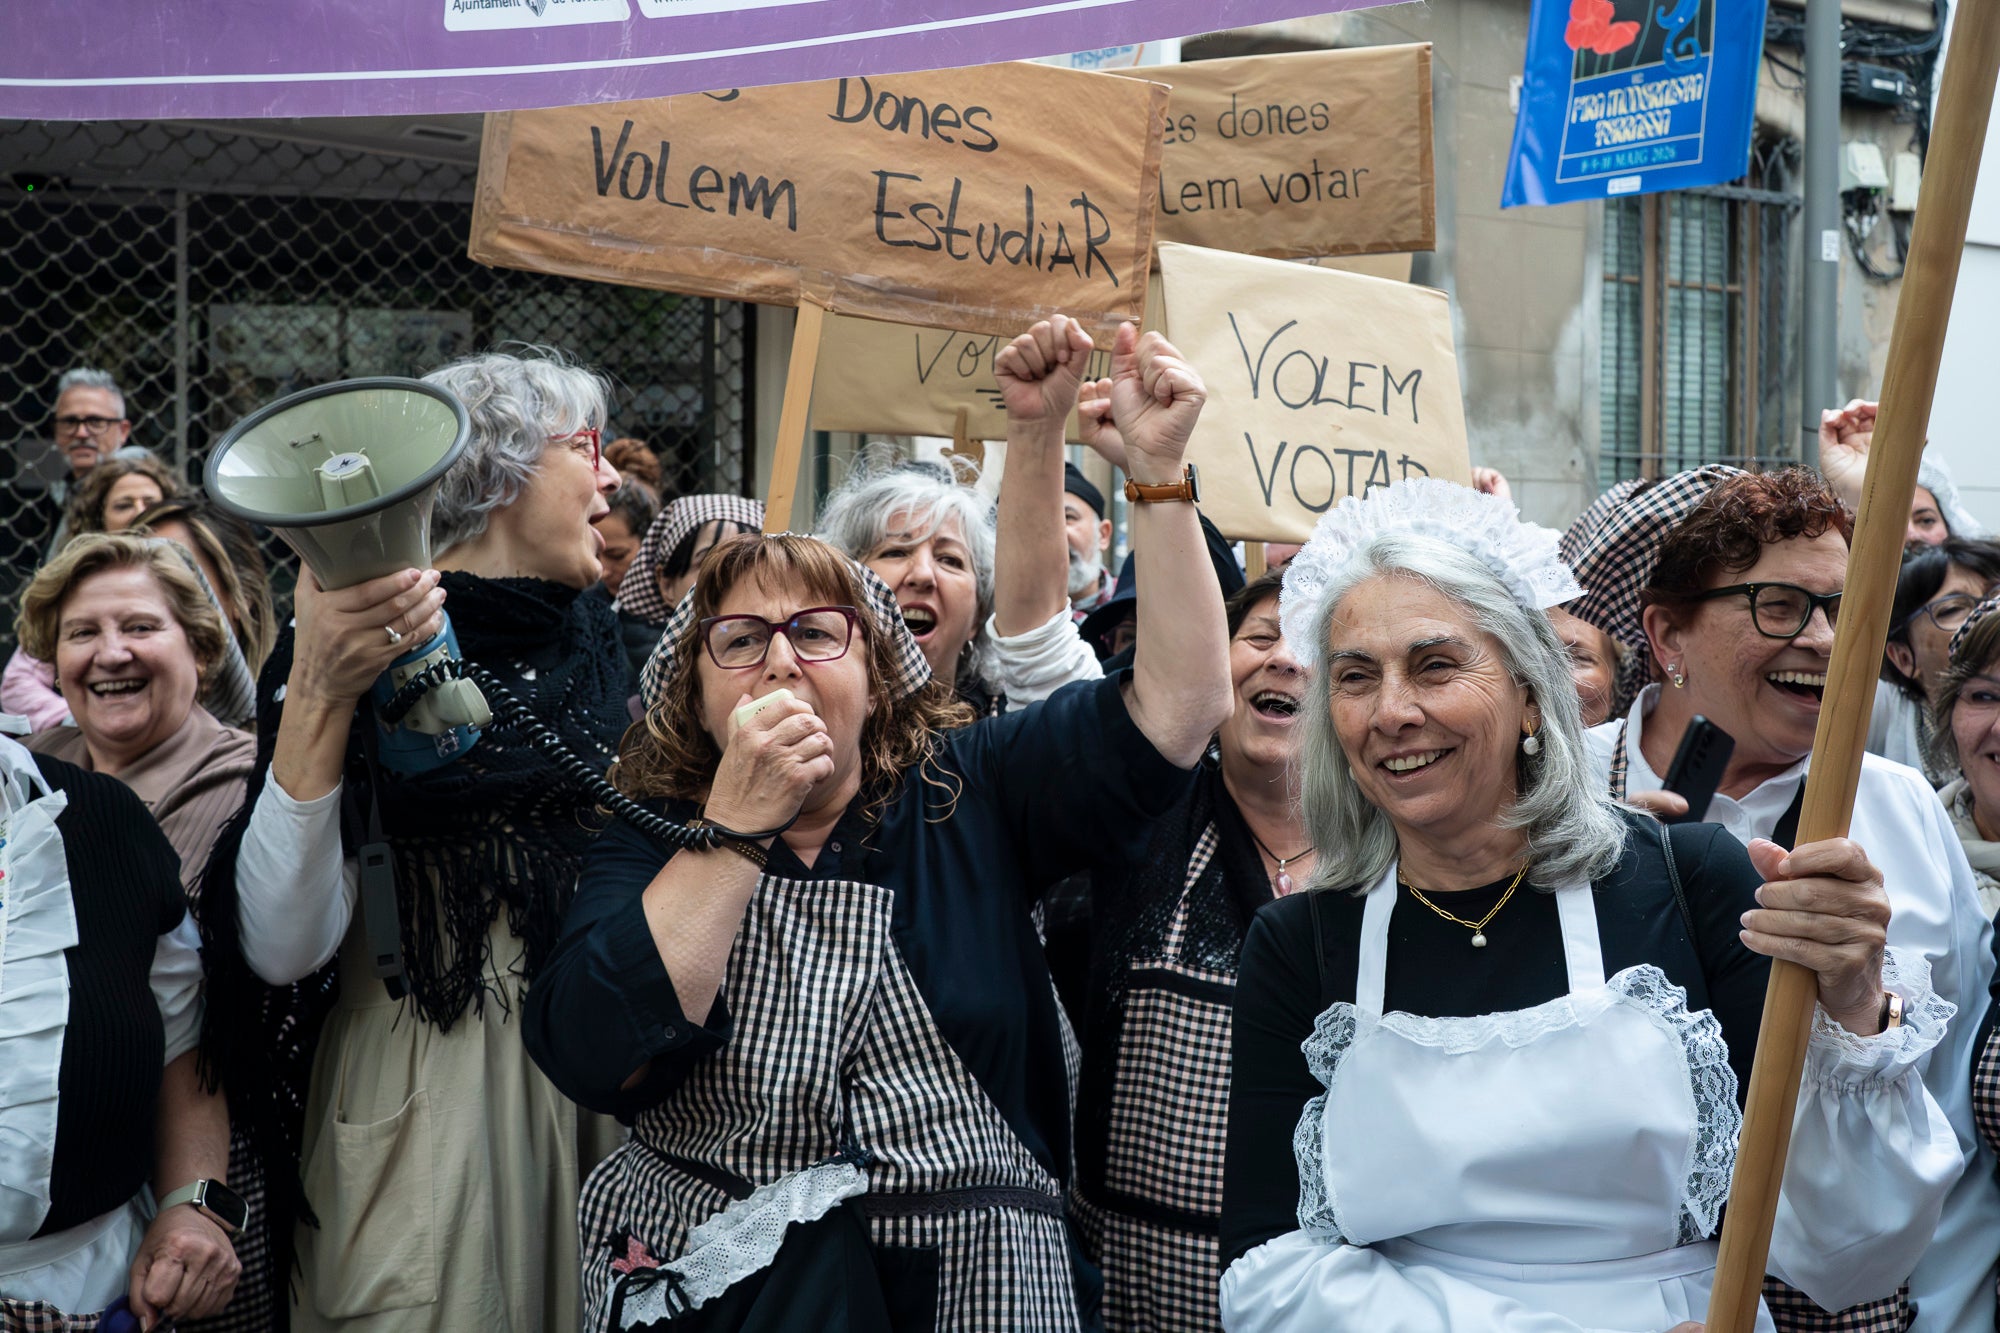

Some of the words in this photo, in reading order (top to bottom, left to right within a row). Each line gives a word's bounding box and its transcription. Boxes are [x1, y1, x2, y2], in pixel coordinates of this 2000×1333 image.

[828, 76, 998, 152] Dones
[1217, 93, 1330, 139] dones
[1260, 158, 1370, 204] votar
[1227, 311, 1423, 424] VOLEM
